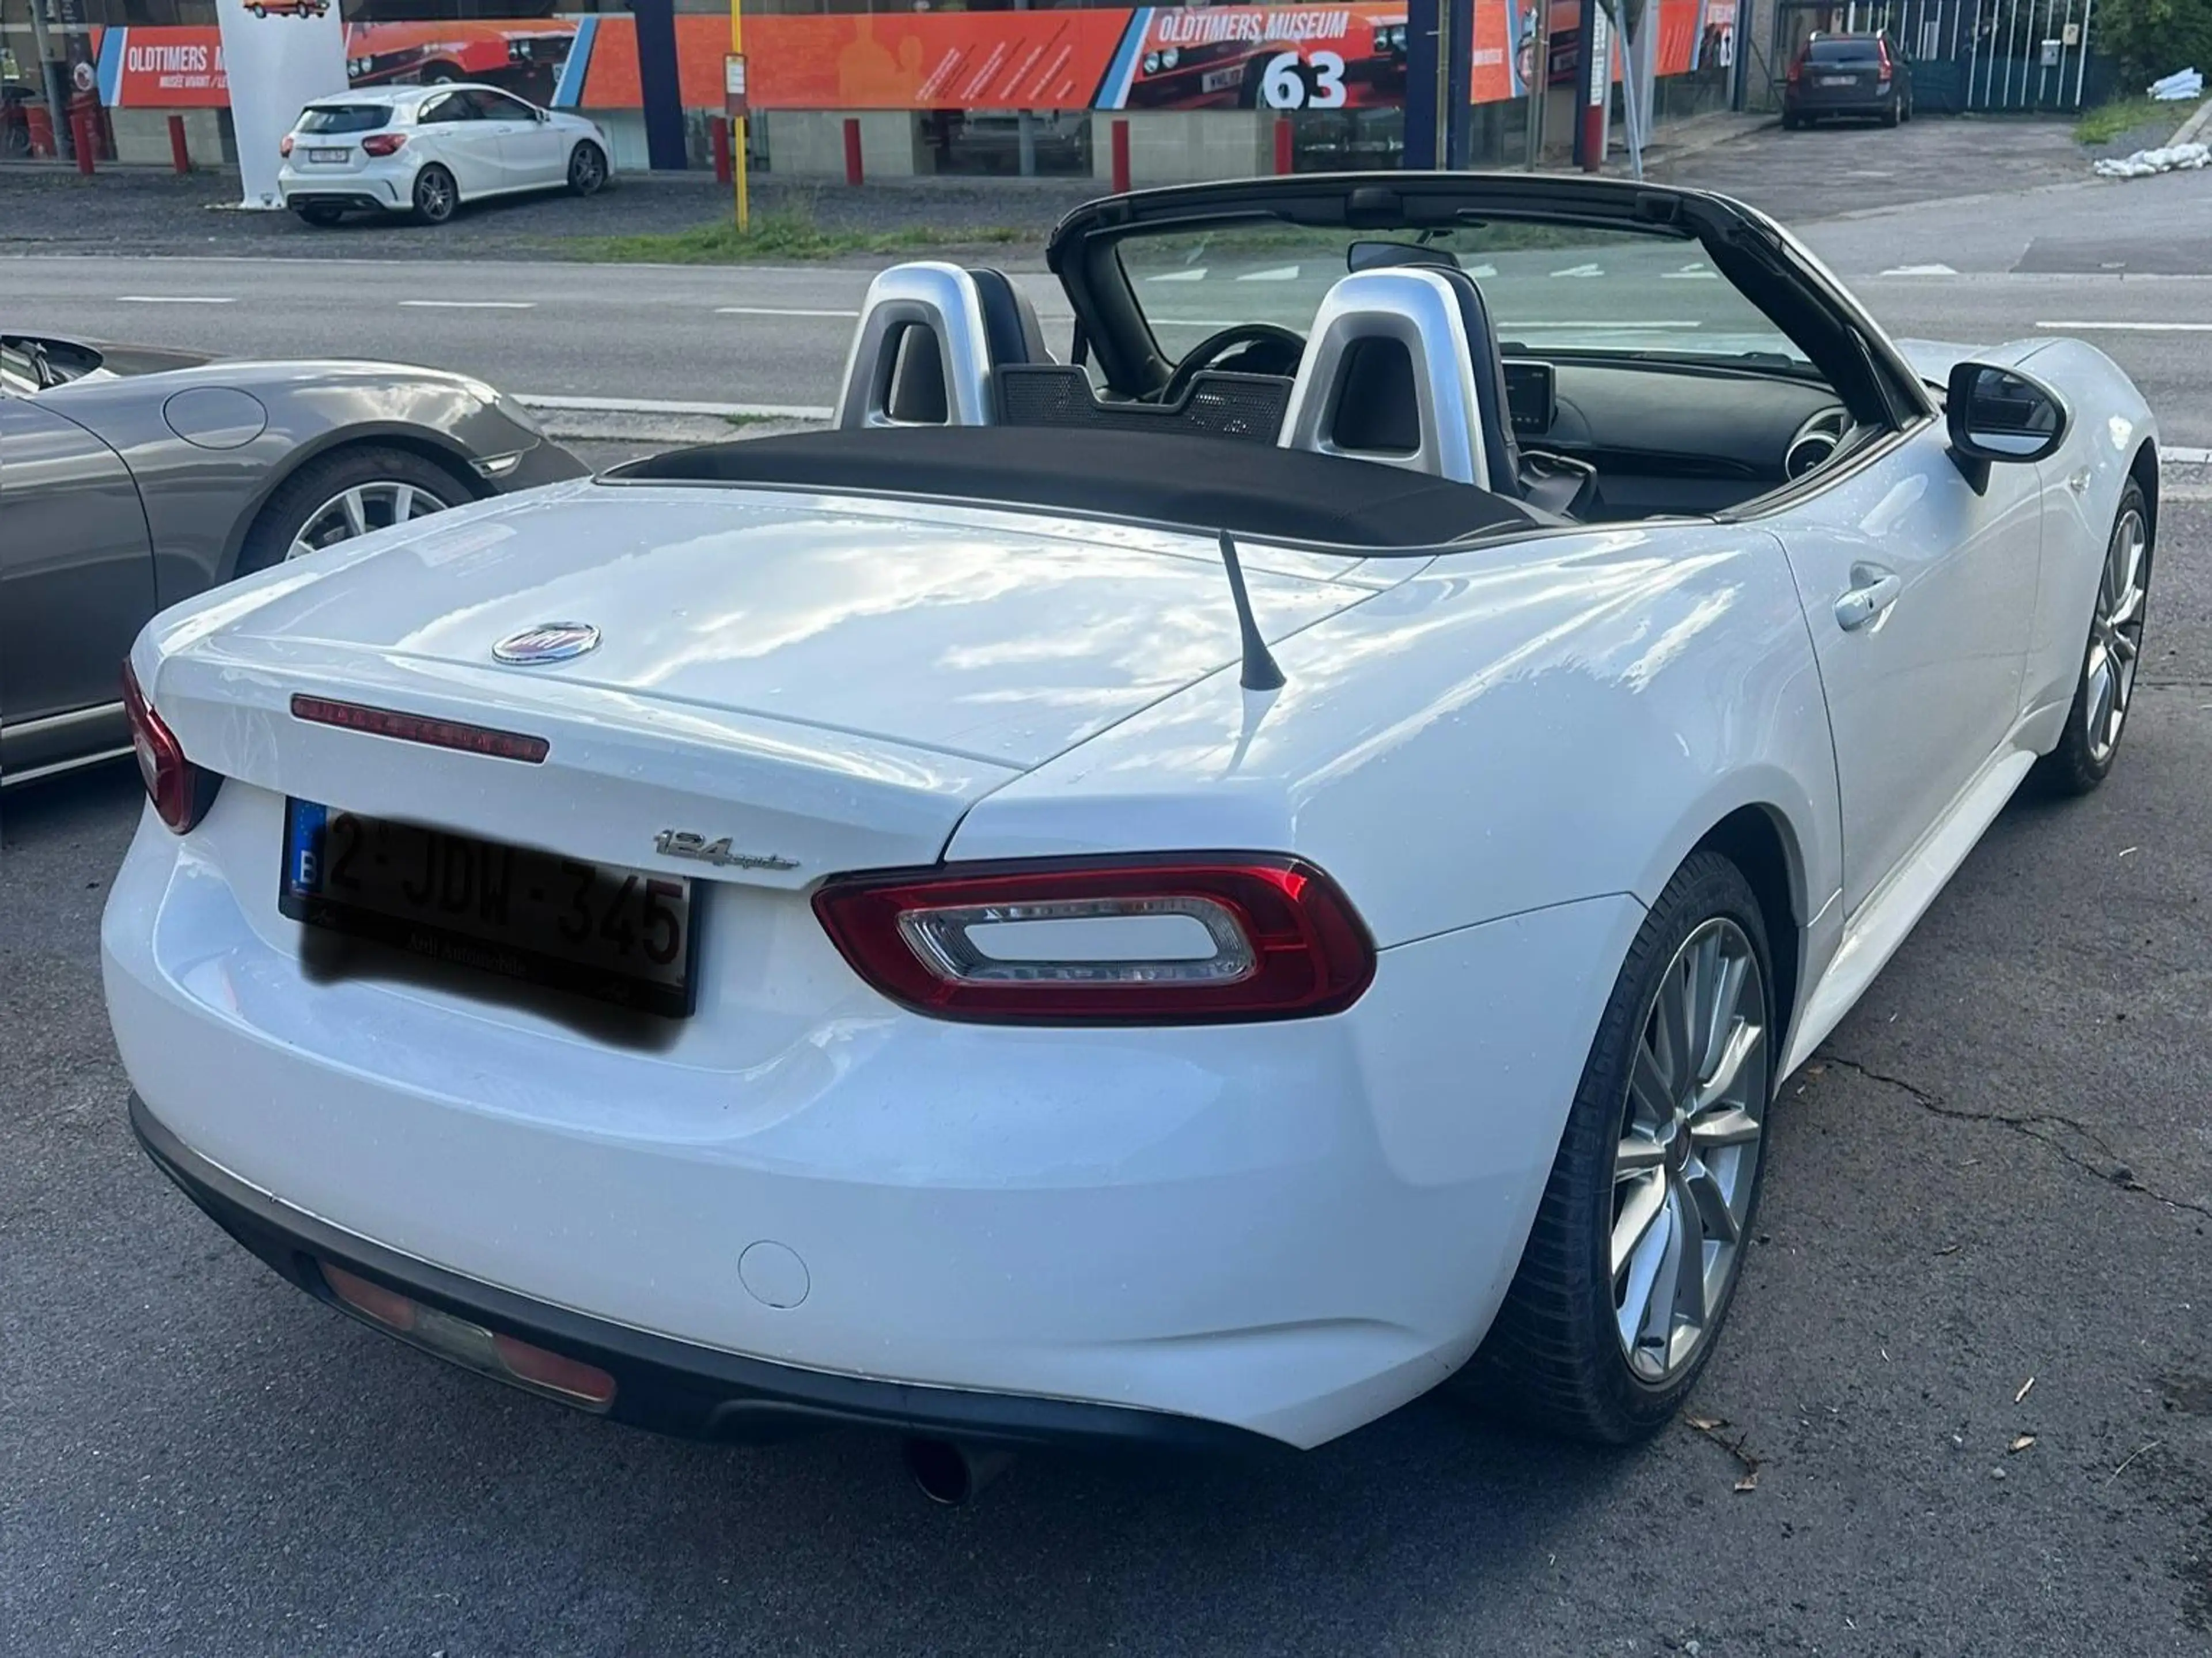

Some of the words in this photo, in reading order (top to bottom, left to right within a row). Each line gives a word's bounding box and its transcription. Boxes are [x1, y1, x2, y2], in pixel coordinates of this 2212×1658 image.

[1159, 13, 1263, 42] OLDTIMERS
[1265, 11, 1349, 39] MUSEUM
[128, 46, 208, 72] OLDTIMERS
[1263, 50, 1347, 109] 63
[654, 829, 733, 866] 124
[300, 849, 317, 883] B
